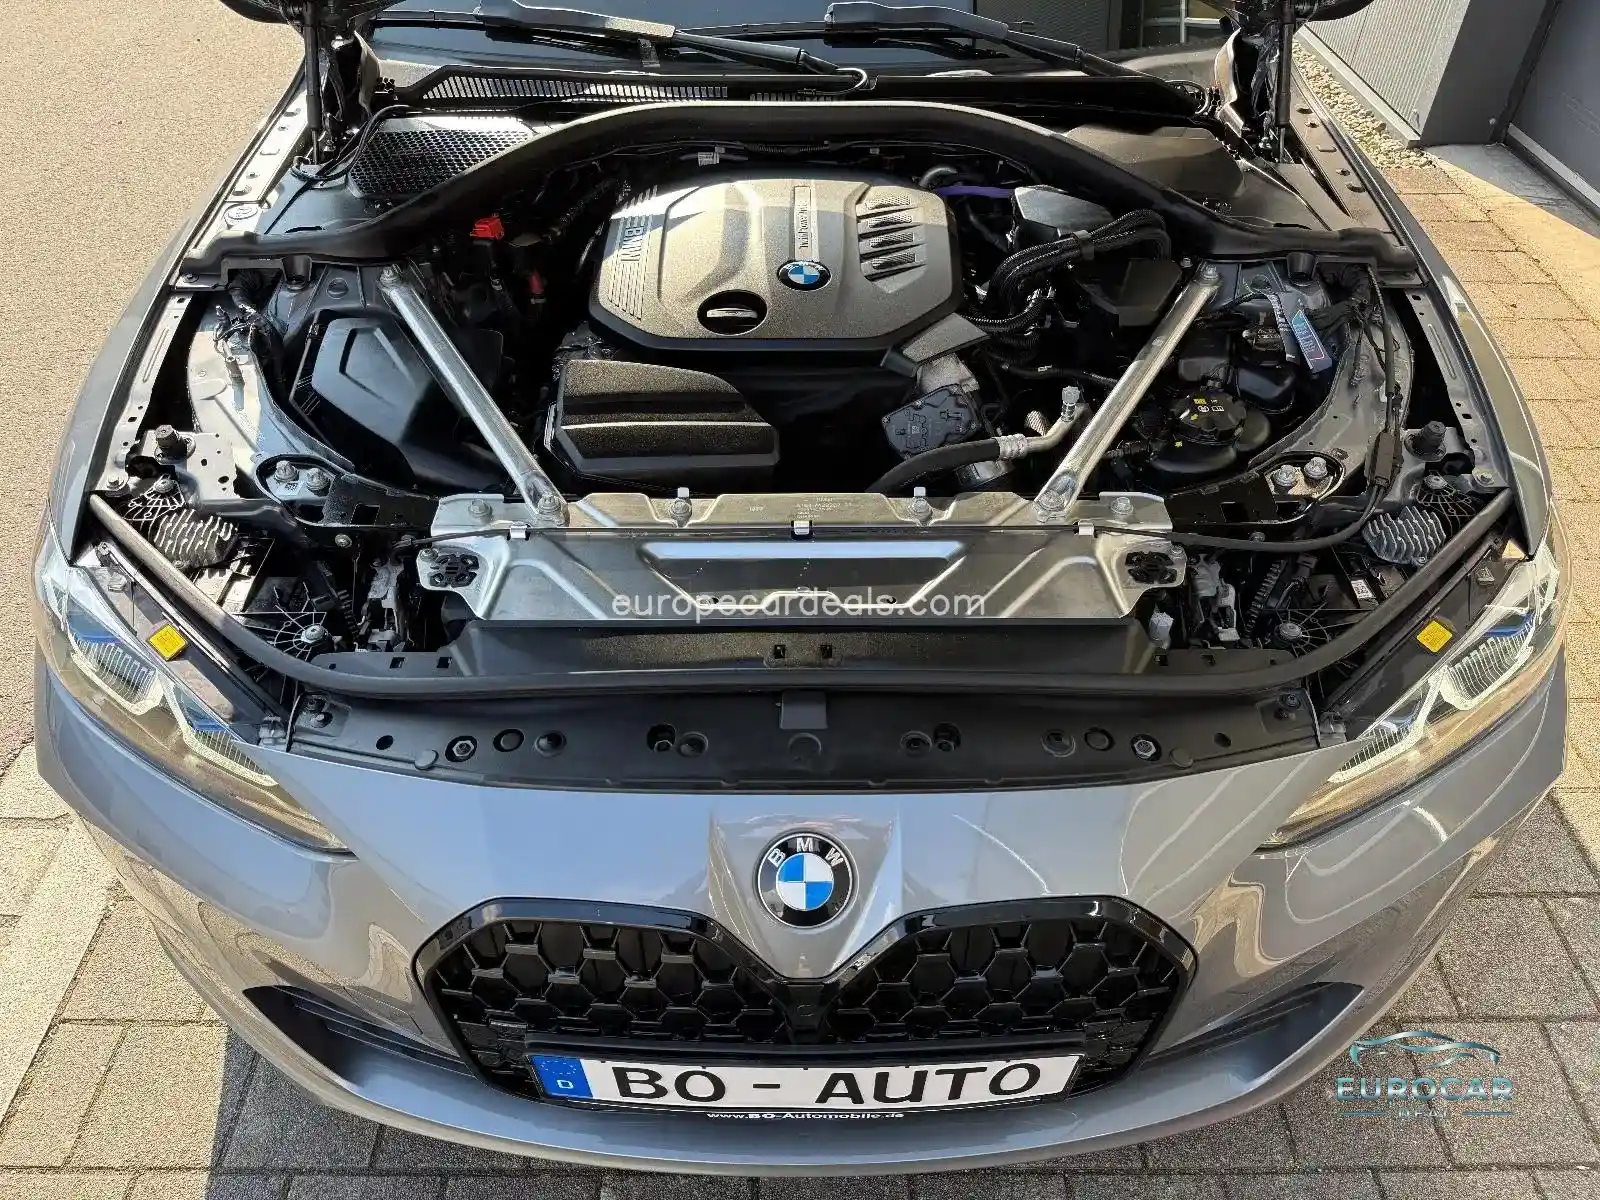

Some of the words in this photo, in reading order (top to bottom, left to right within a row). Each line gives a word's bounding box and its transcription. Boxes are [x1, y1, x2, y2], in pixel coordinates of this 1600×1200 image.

[620, 227, 644, 262] BMW
[767, 837, 844, 868] BMW
[557, 1078, 574, 1090] D
[612, 1066, 726, 1103] BO
[814, 1063, 1041, 1104] AUTO
[706, 1112, 905, 1120] www.BO-Automobile.de
